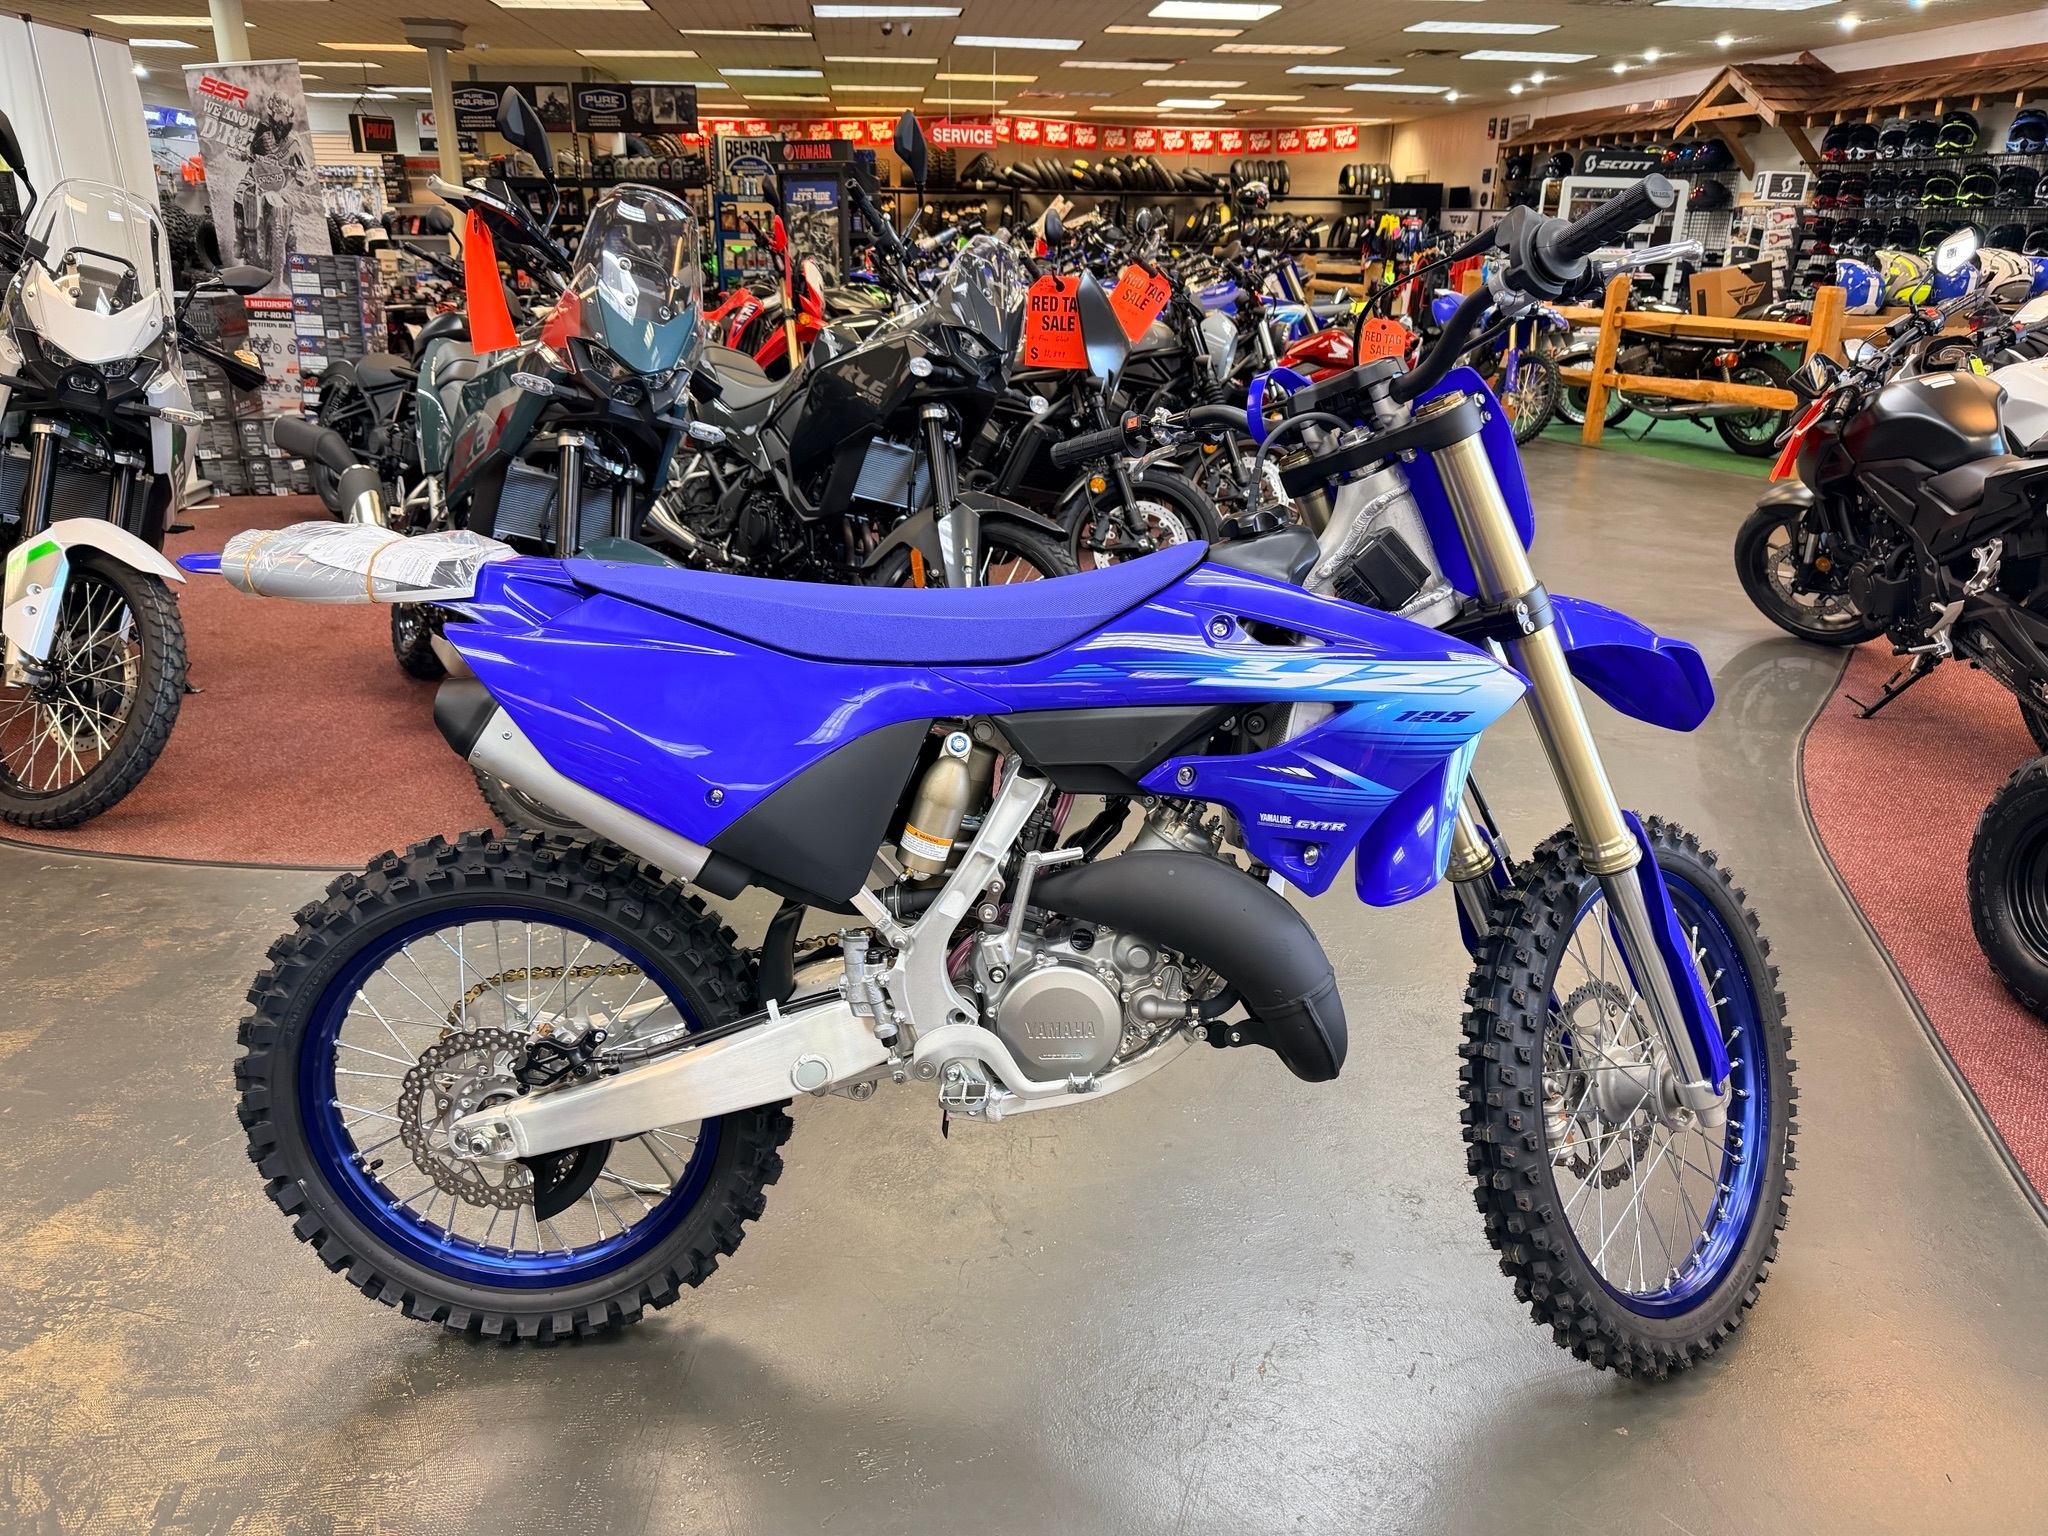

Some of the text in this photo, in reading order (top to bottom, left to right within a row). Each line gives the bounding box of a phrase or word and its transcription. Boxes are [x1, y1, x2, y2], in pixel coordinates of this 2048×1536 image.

[198, 76, 249, 110] SSR
[585, 95, 619, 104] PURE
[454, 98, 496, 106] POLARIS
[203, 100, 261, 130] WE KNOW
[366, 122, 393, 139] PILOT
[933, 128, 993, 144] SERVICE
[793, 143, 832, 160] YAMAHA
[1596, 160, 1655, 171] SCOTT
[792, 191, 812, 201] LET'S
[1123, 272, 1166, 304] RED TAG
[1031, 295, 1078, 313] RED TA
[1122, 288, 1150, 311] SALE
[254, 310, 292, 320] OFF-ROAD
[278, 321, 292, 329] BIKE
[1041, 315, 1076, 332] SALE
[1364, 330, 1402, 344] RED TAG
[1030, 346, 1039, 361] $
[1369, 344, 1393, 356] SALE
[837, 364, 888, 398] KLE
[862, 391, 883, 405] 500
[1190, 660, 1500, 695] YZ
[1393, 710, 1475, 723] 125
[1259, 813, 1292, 825] YAMALUBE
[1294, 820, 1348, 832] GYTR
[1024, 1021, 1096, 1039] YAMAHA
